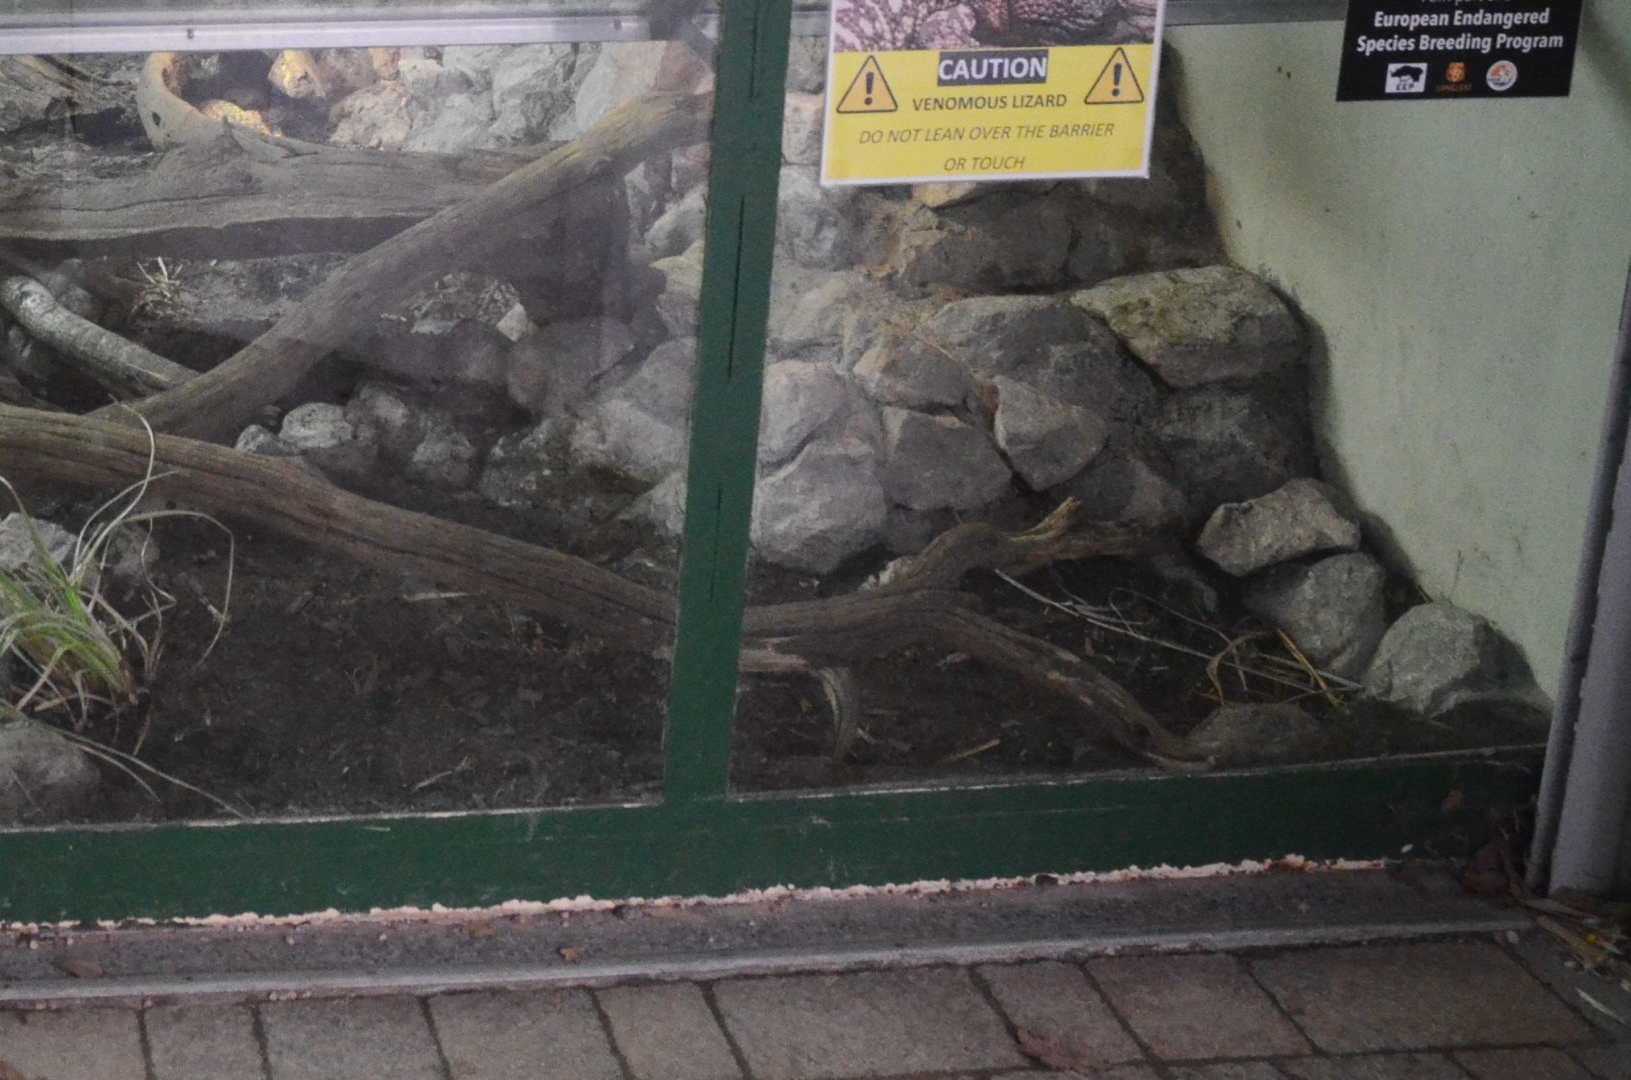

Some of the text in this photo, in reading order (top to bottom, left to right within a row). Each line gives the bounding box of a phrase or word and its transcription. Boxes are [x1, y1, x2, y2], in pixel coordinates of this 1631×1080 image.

[1374, 8, 1550, 31] European Endangered
[1357, 33, 1564, 55] Species Breeding Program
[938, 57, 1047, 80] CAUTION
[913, 94, 1067, 112] VENOMOUS LIZARD
[859, 122, 1115, 144] DO NOT LEAN OVER THE BARRIER
[944, 156, 1025, 171] OR TOUCH
